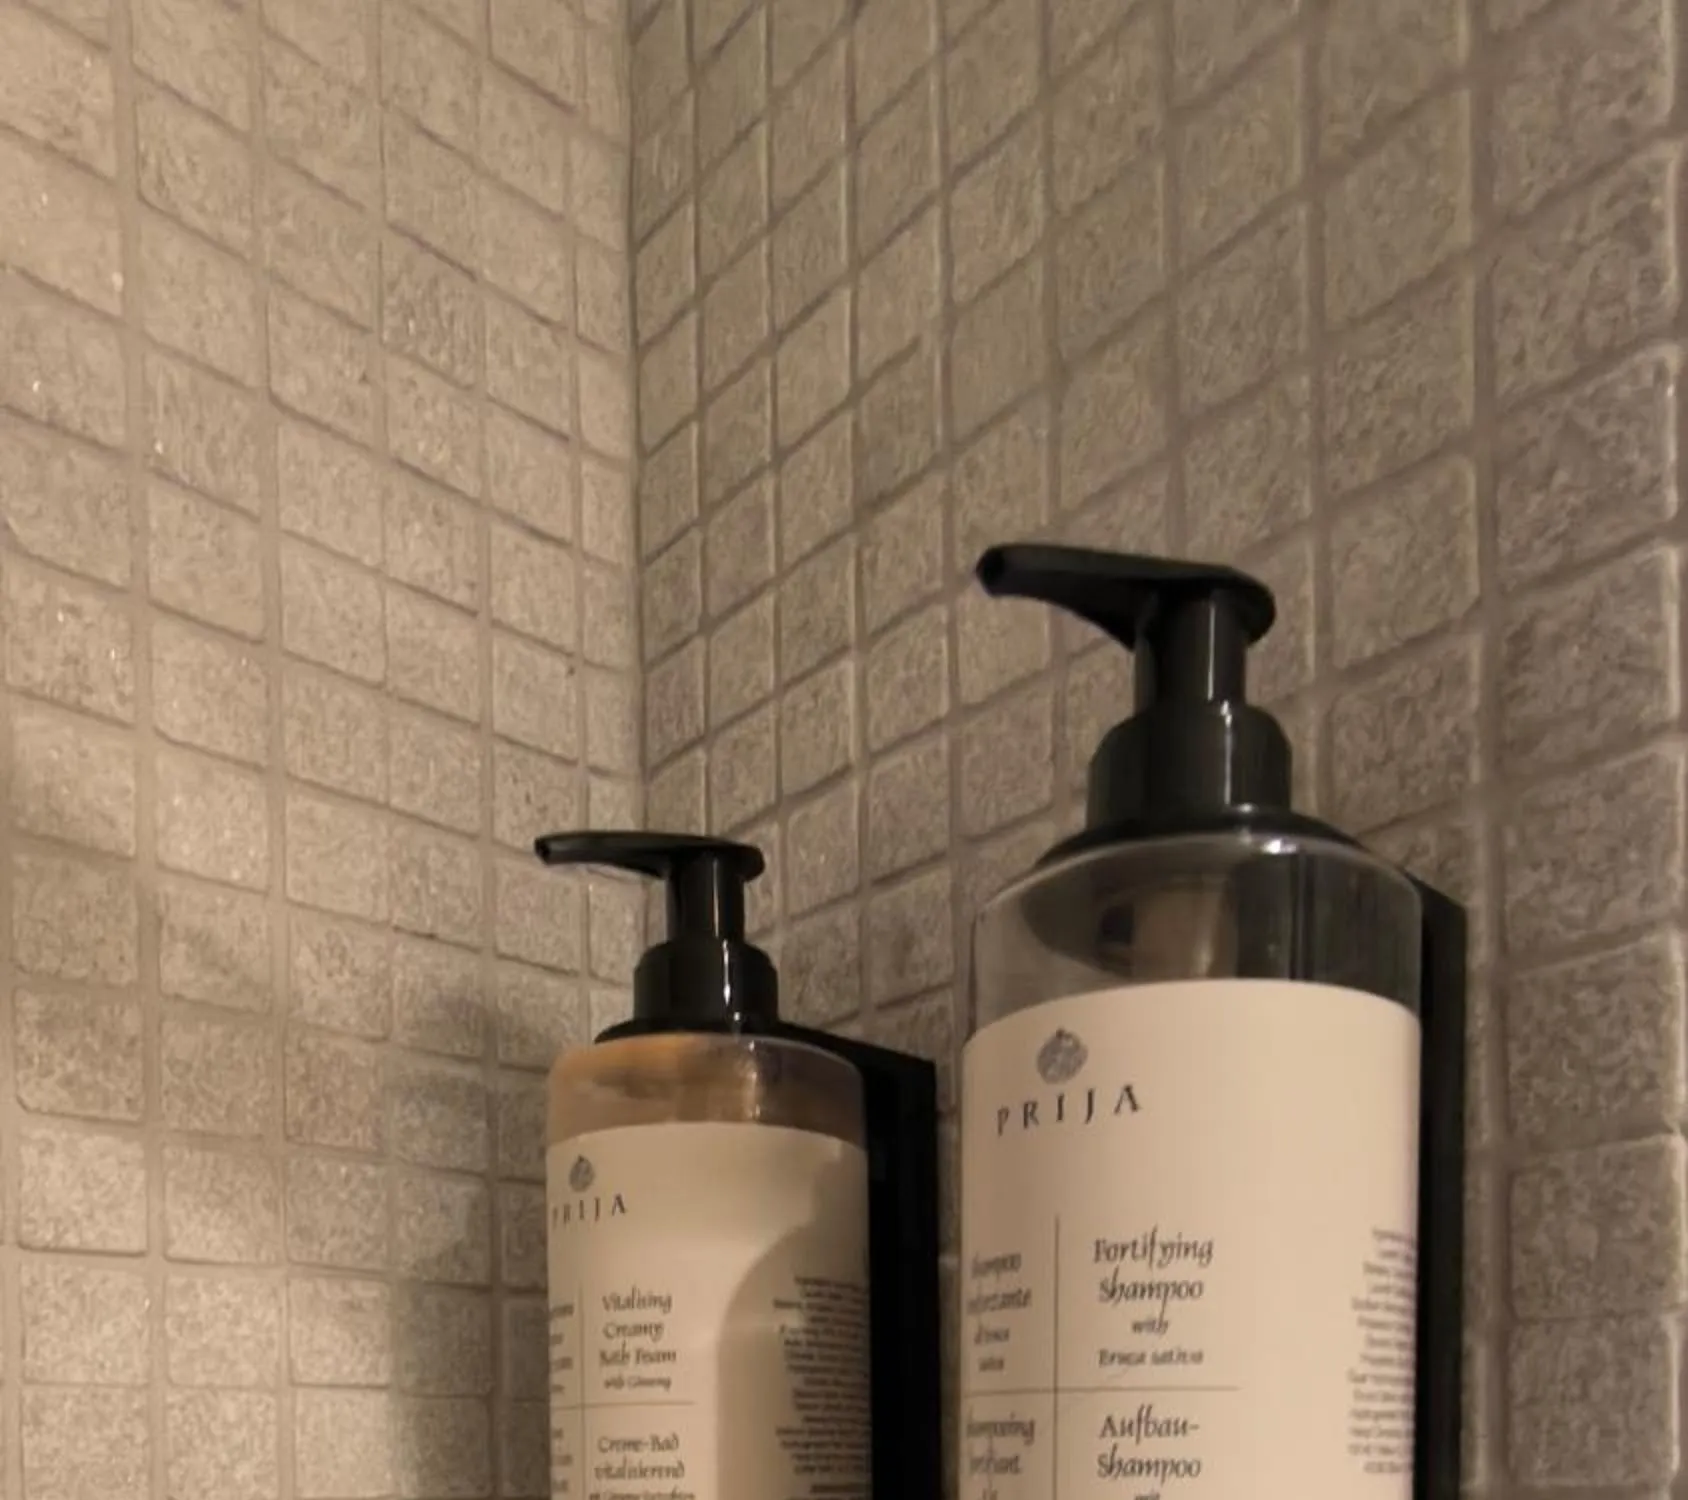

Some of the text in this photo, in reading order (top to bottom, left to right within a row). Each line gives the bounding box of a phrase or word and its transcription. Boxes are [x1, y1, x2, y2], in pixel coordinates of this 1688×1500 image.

[996, 1083, 1142, 1137] PRIJA
[1093, 1224, 1214, 1269] Fortifying
[603, 1322, 664, 1342] Creamy
[1131, 1314, 1169, 1336] with
[1099, 1404, 1200, 1442] Aufbau-
